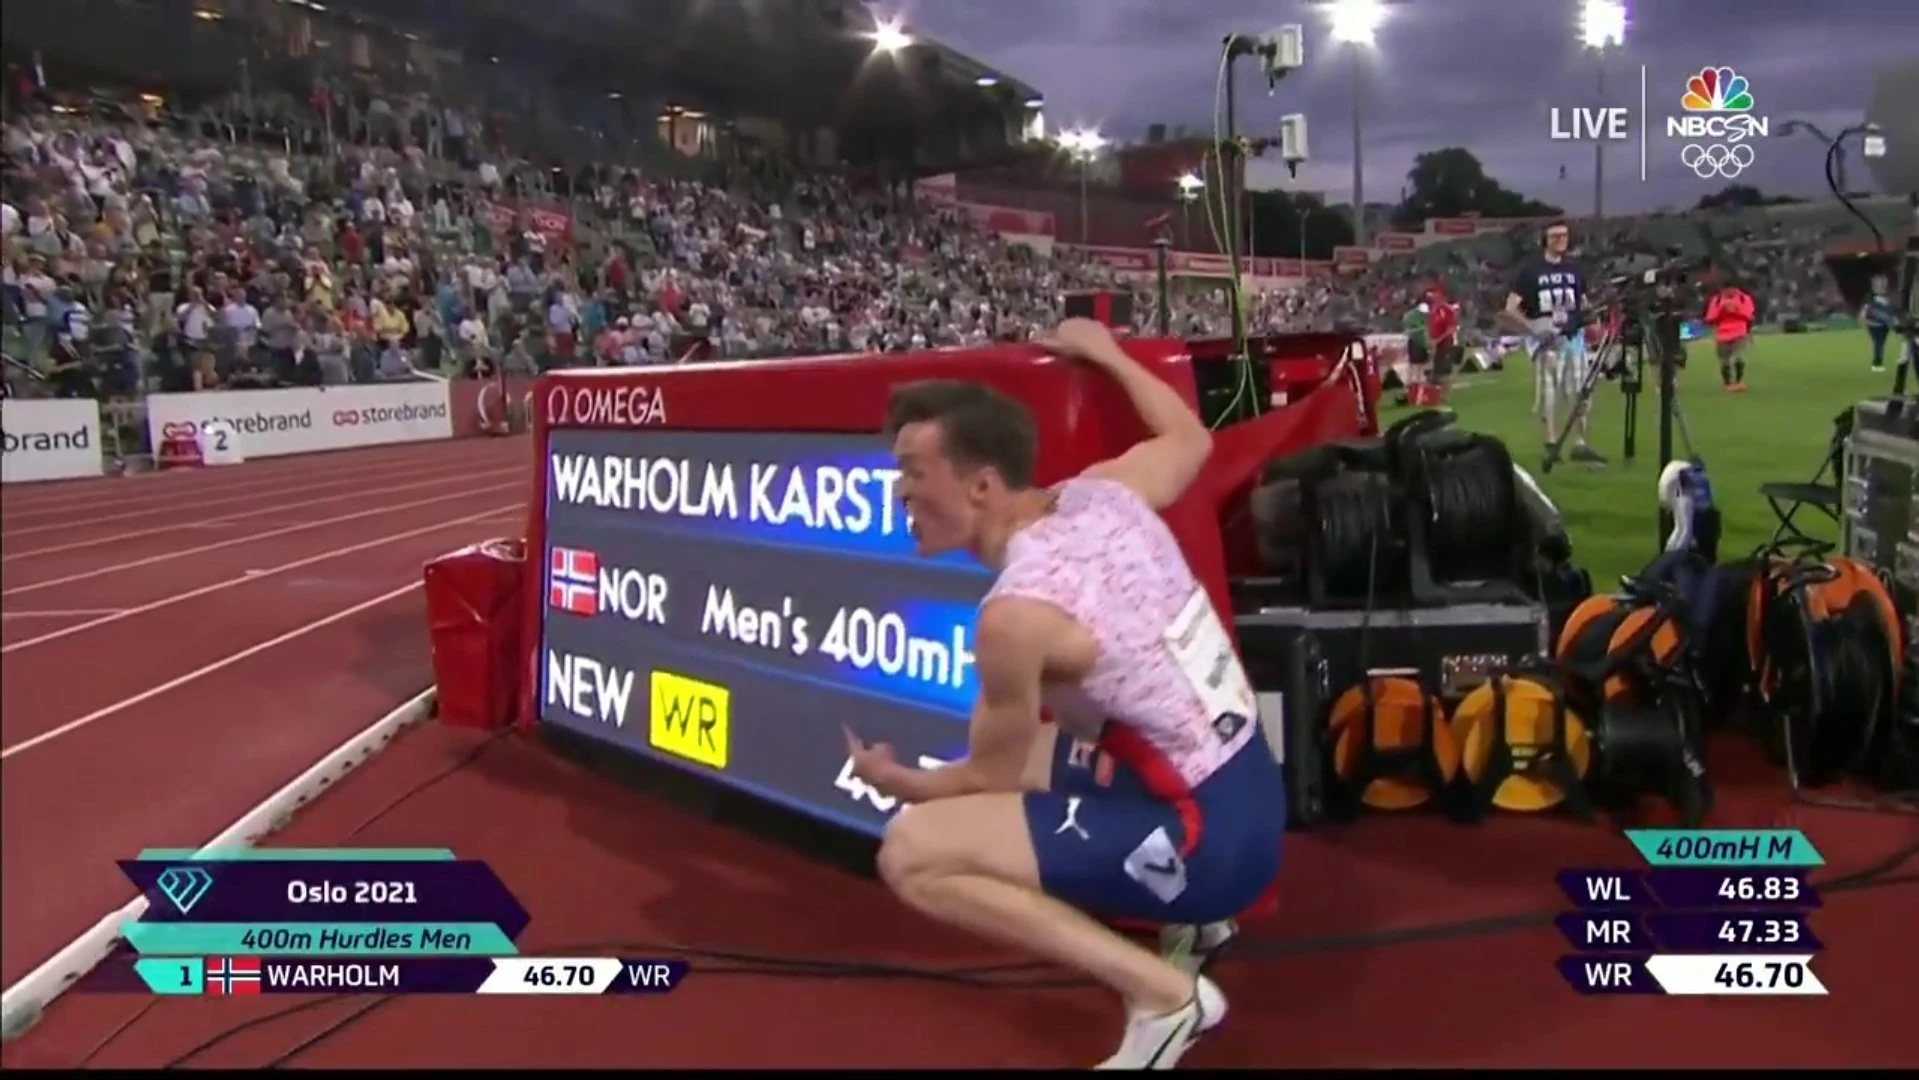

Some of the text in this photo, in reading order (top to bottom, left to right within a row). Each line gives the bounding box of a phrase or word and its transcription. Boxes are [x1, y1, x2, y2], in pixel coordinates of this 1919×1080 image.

[201, 408, 312, 433] rebrand
[361, 401, 446, 424] storebrand
[574, 387, 667, 424] OMEGA
[214, 431, 228, 451] 2
[552, 454, 914, 535] WARHOLM KARST
[600, 567, 668, 624] NOR
[702, 584, 809, 655] Men's
[547, 650, 717, 752] NEW WR
